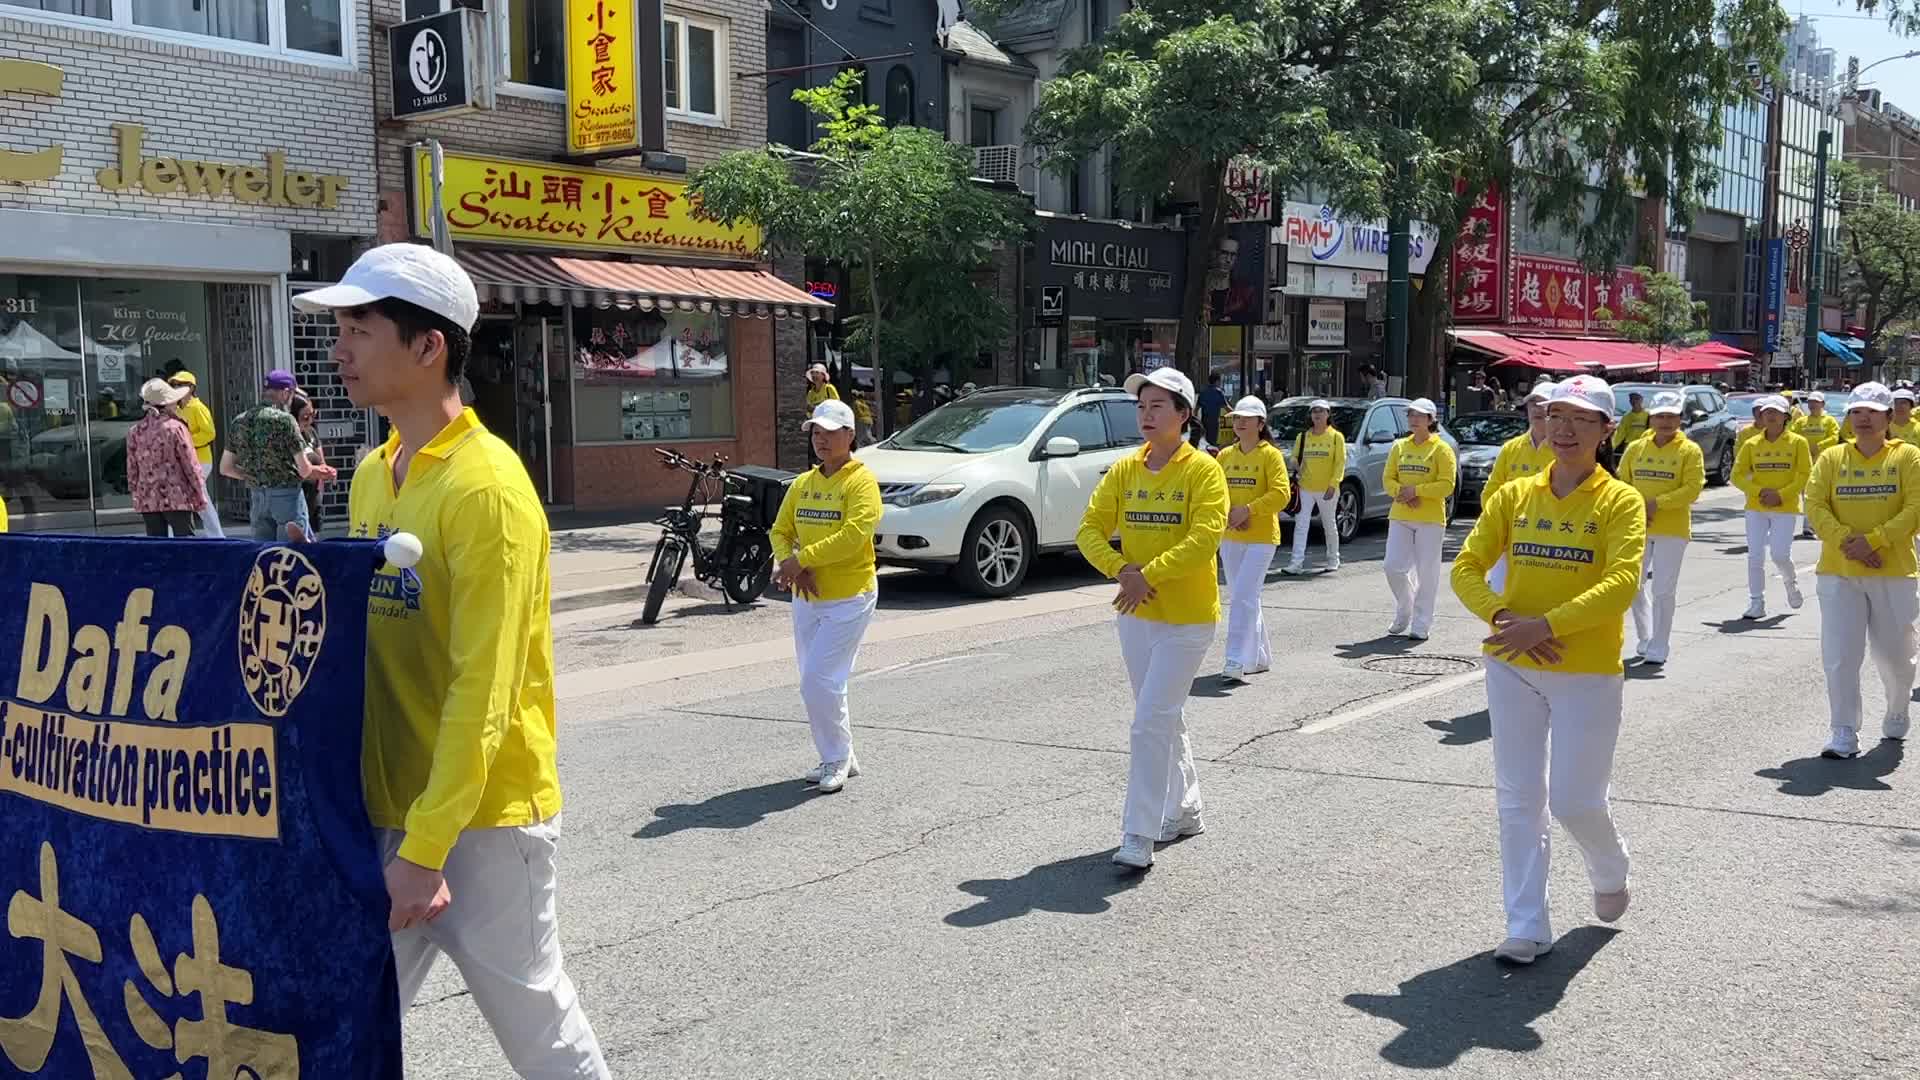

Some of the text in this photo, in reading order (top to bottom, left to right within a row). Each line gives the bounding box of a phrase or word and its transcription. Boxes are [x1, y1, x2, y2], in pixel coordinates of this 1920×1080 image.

[423, 93, 447, 105] SMILES
[575, 100, 632, 119] Swatow
[96, 121, 348, 209] Jeweler
[447, 191, 748, 256] Swatow Restaurant
[1286, 217, 1333, 248] AMY
[1352, 226, 1423, 259] WIRESS
[1051, 239, 1149, 269] MINH CHAU
[6, 298, 38, 314] 311
[113, 307, 141, 321] Kim
[97, 324, 137, 342] KC
[1554, 548, 1590, 561] DAFA
[16, 581, 192, 722] Dafa
[142, 726, 272, 826] practice
